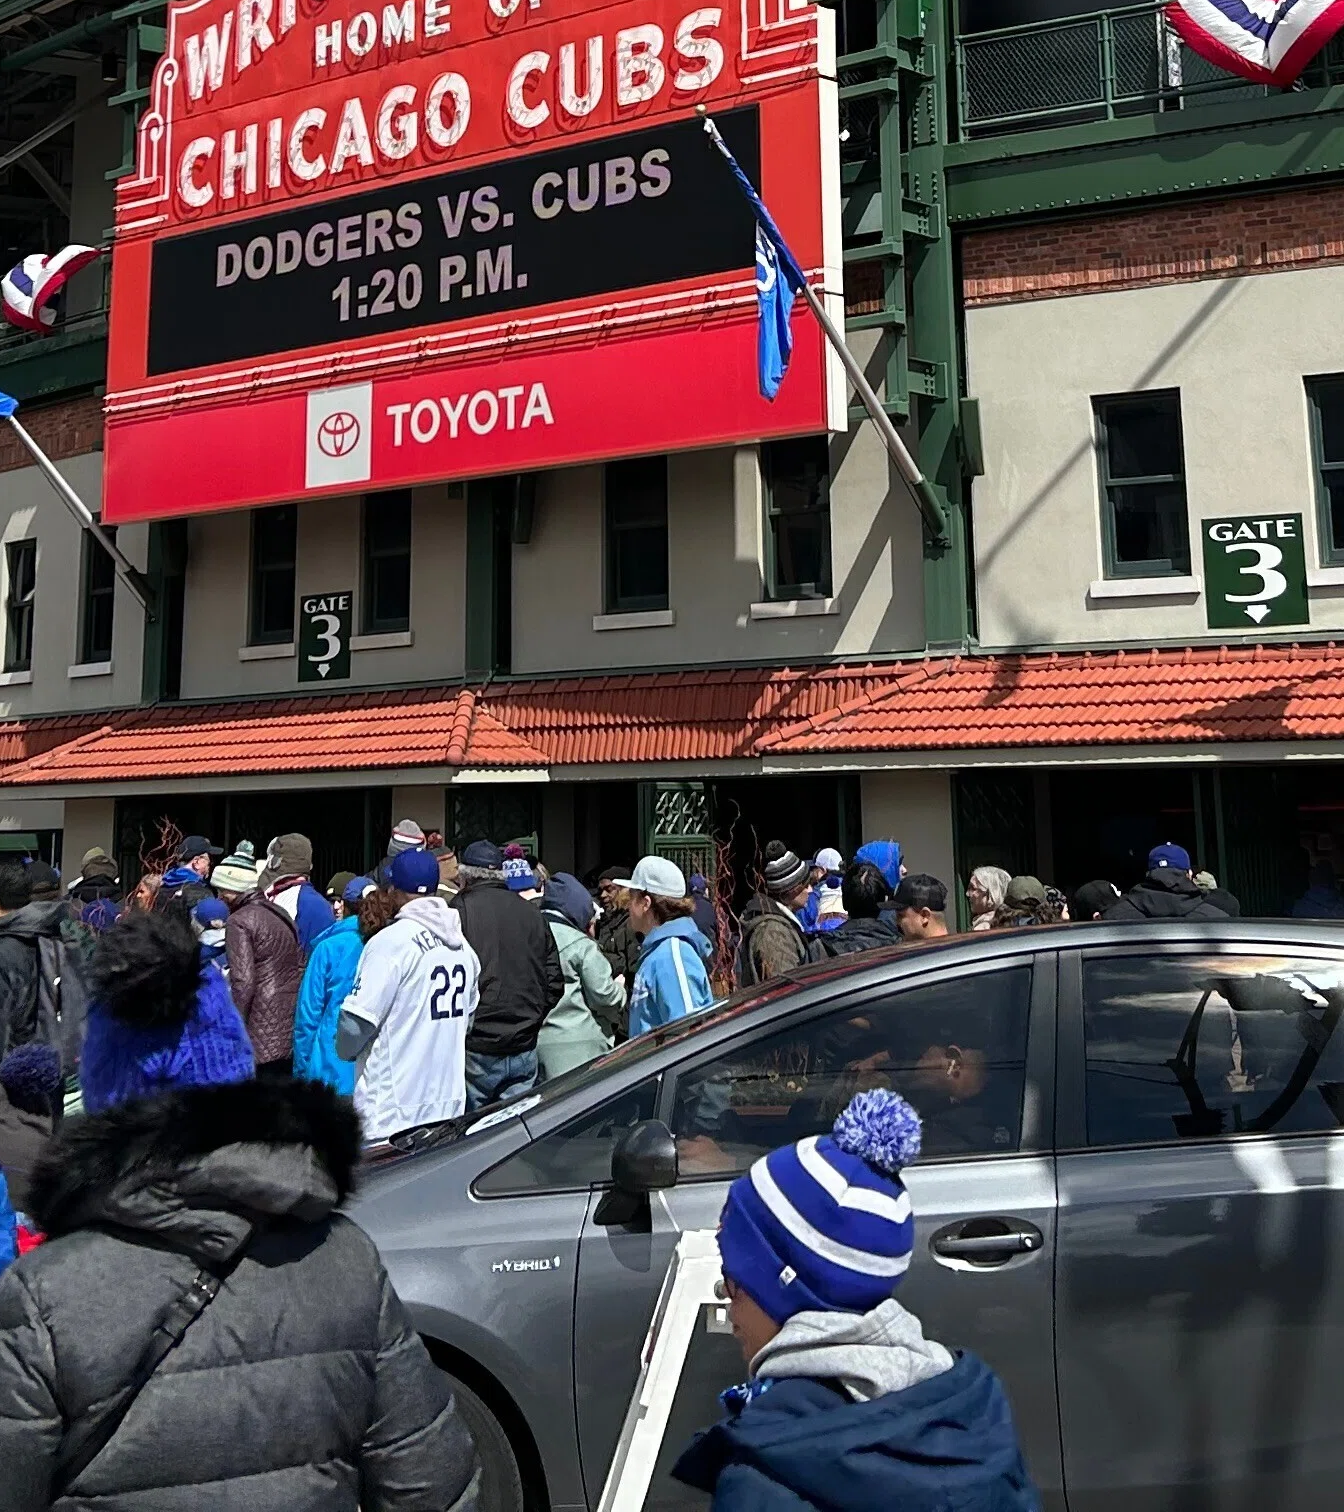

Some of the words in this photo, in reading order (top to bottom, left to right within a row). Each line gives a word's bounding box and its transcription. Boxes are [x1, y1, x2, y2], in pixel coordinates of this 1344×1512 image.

[178, 70, 472, 208] CHICAGO
[505, 6, 725, 129] CUBS
[215, 202, 423, 288] DODGERS
[437, 185, 515, 240] VS.
[531, 148, 673, 221] CUBS
[331, 264, 424, 323] 1:20
[438, 244, 529, 304] P.M.
[386, 382, 555, 448] TOYOTA
[1208, 519, 1296, 542] GATE
[1224, 542, 1287, 604] 3
[303, 595, 350, 614] GATE
[308, 614, 342, 662] 3
[430, 964, 466, 1020] 22
[492, 1258, 551, 1272] HYBRID
